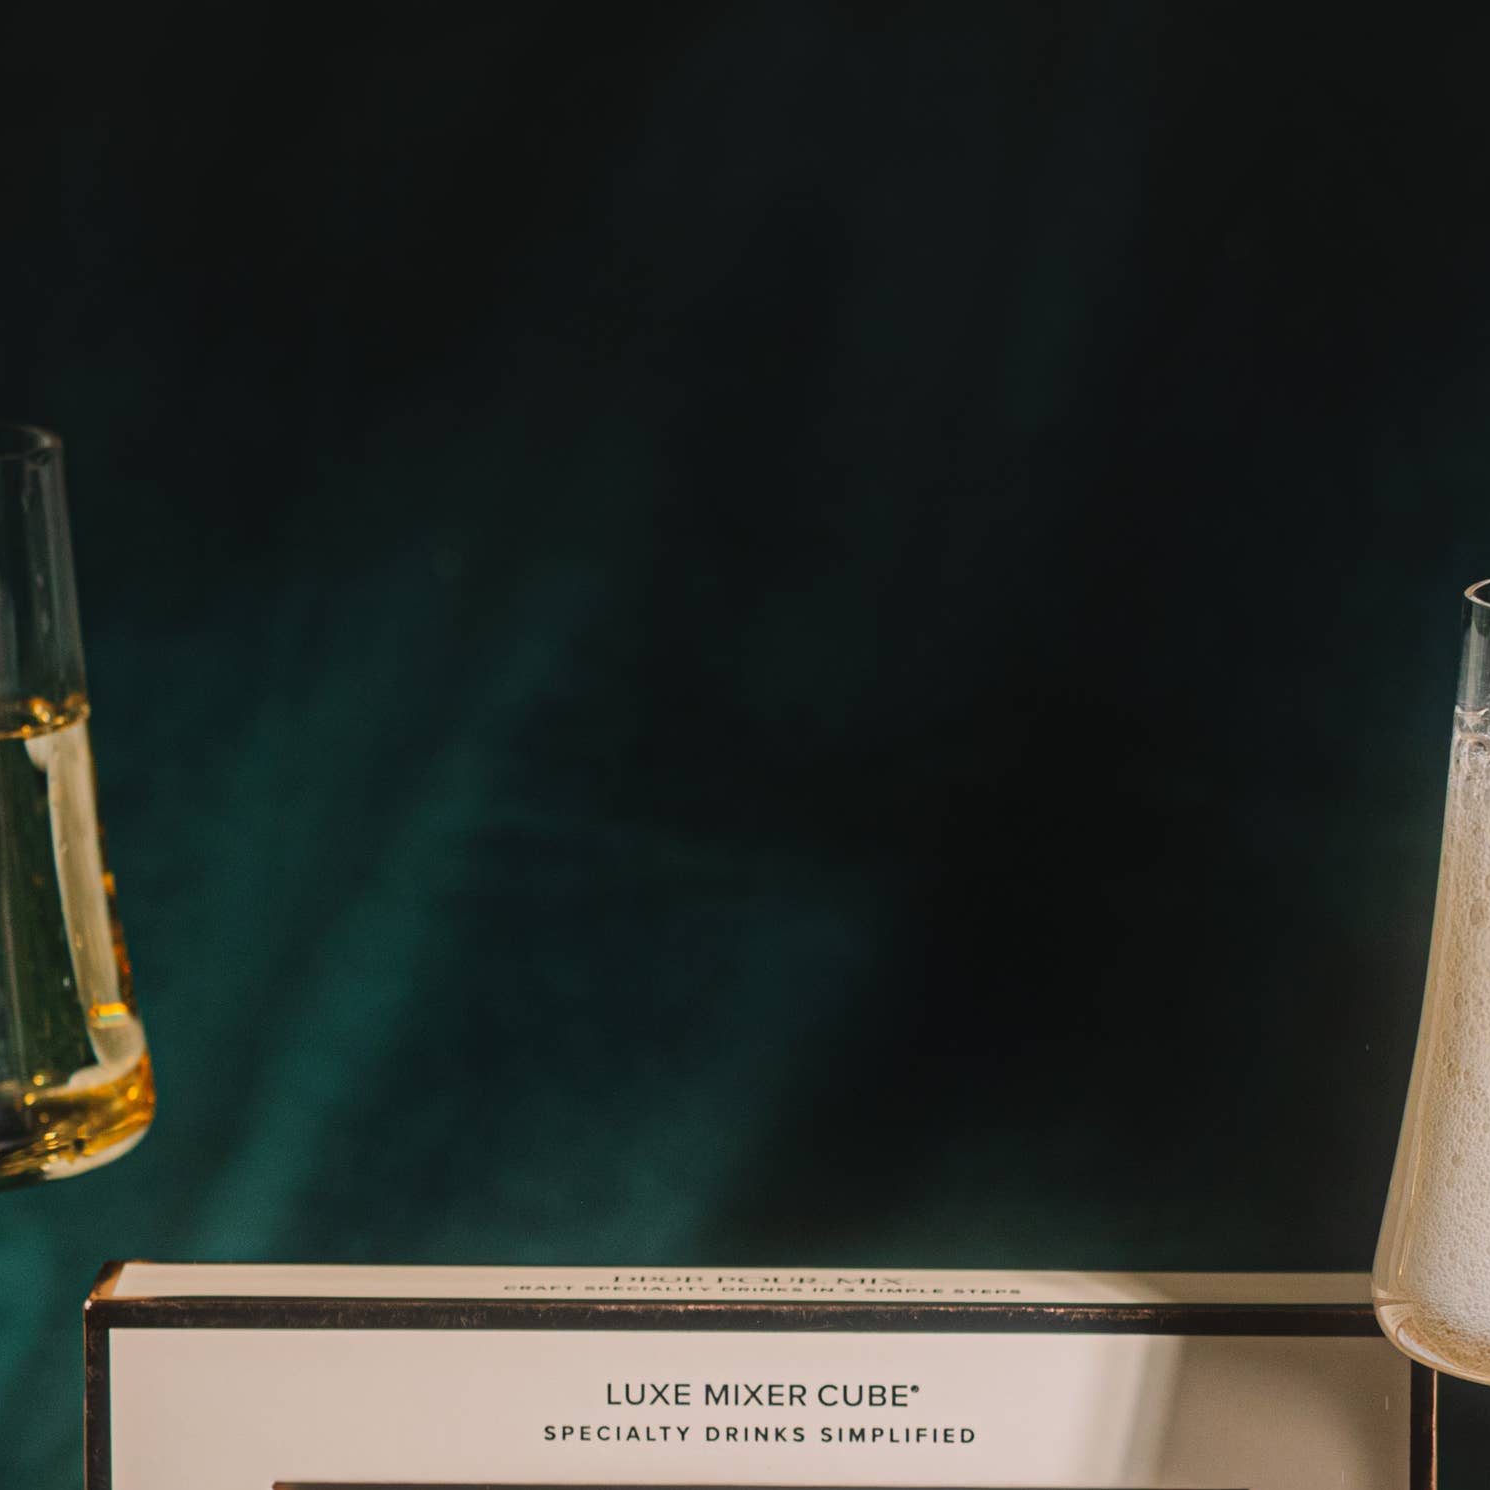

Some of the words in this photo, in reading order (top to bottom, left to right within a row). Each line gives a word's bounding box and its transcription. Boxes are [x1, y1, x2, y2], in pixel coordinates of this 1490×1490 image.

[606, 1383, 691, 1406] LUXE
[704, 1383, 807, 1407] MIXER
[543, 1425, 690, 1442] SPECIALTY
[705, 1426, 805, 1443] DRINKS
[820, 1426, 975, 1444] SIMPLIFIED
